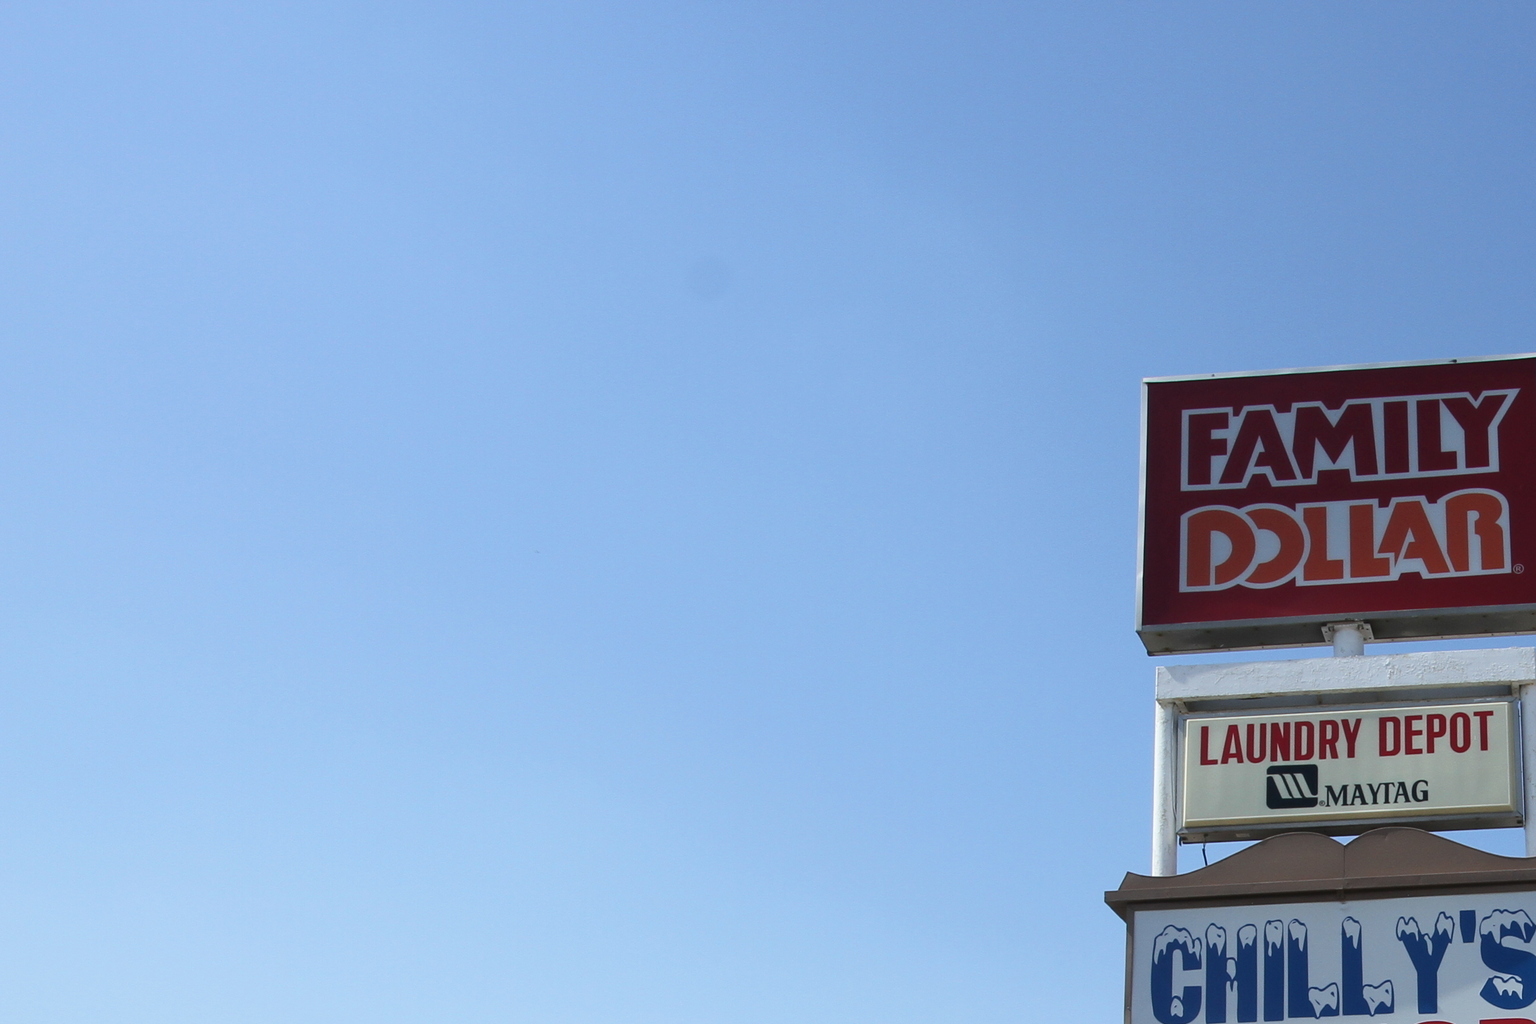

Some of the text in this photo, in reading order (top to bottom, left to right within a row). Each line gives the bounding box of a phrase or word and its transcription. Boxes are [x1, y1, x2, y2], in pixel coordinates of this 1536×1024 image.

[1181, 388, 1521, 492] FAMILY
[1179, 488, 1512, 593] DOLLAR
[1200, 711, 1494, 766] LAUNDRY DEPOT
[1325, 779, 1429, 807] MAYTAG
